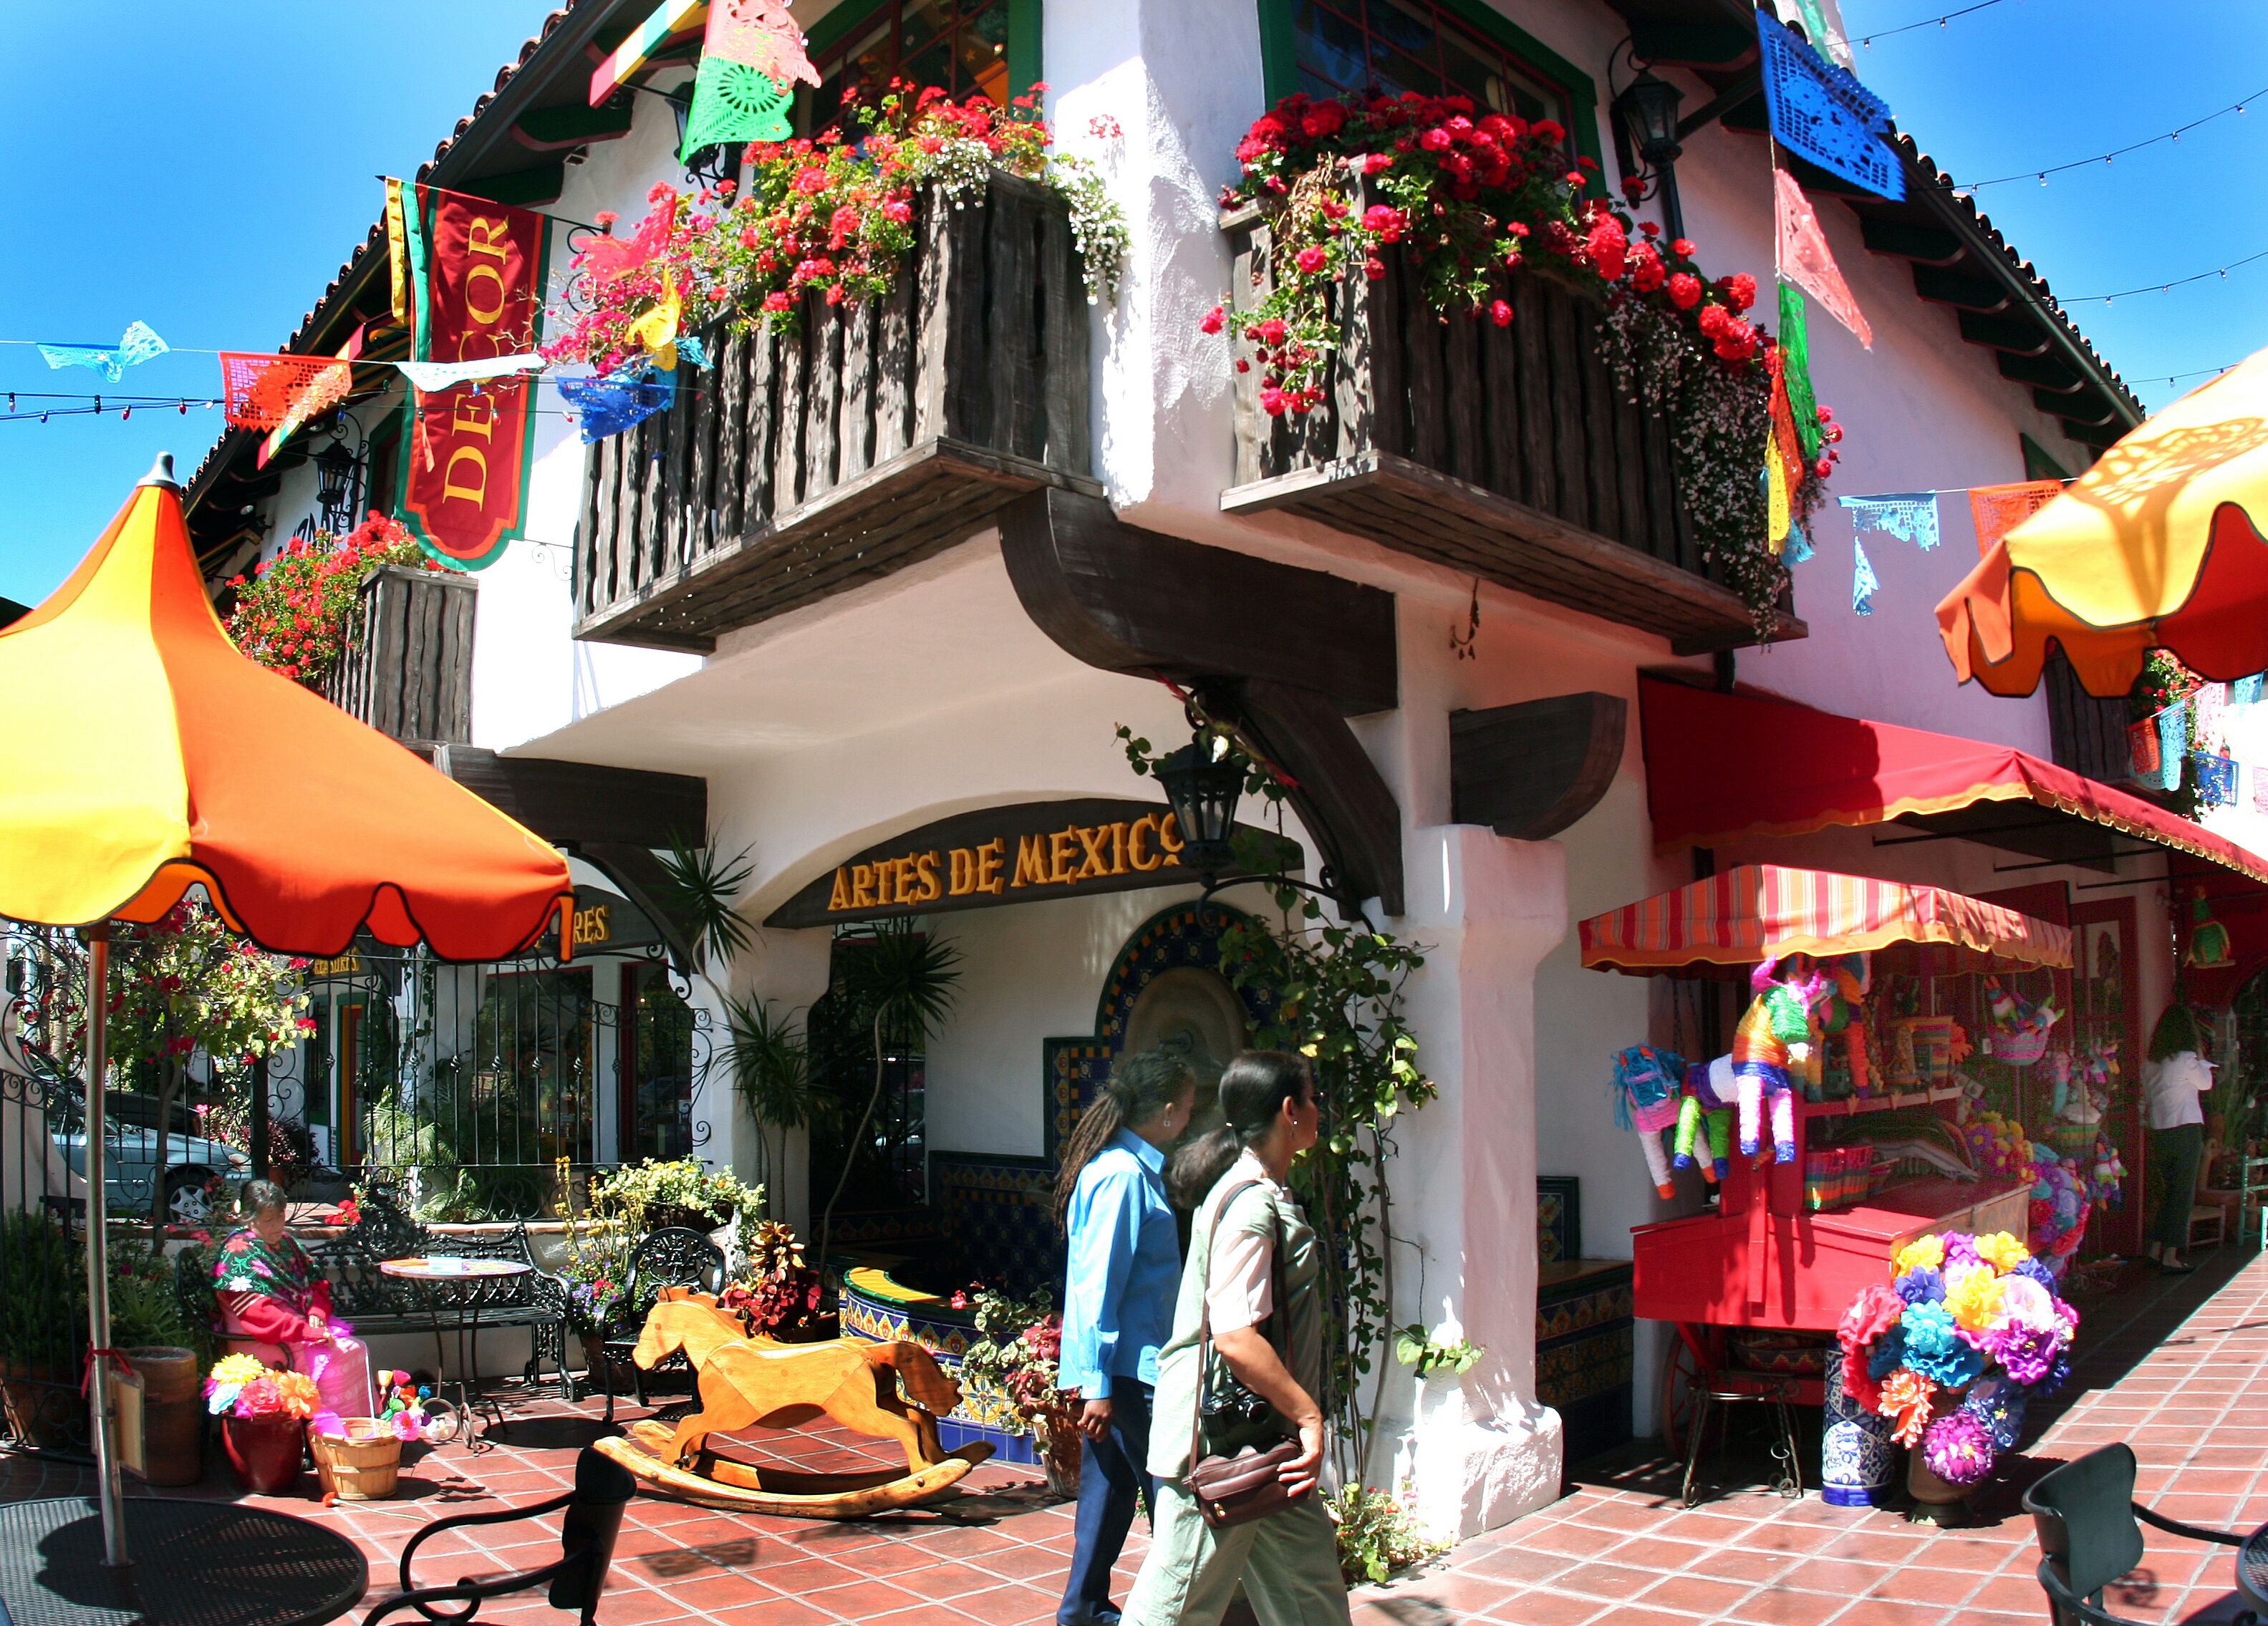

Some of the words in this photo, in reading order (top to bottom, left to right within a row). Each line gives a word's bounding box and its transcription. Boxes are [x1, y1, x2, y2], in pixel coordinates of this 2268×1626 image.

[442, 216, 509, 512] DECOR
[827, 849, 942, 911] ARTES
[949, 837, 1004, 896] DE
